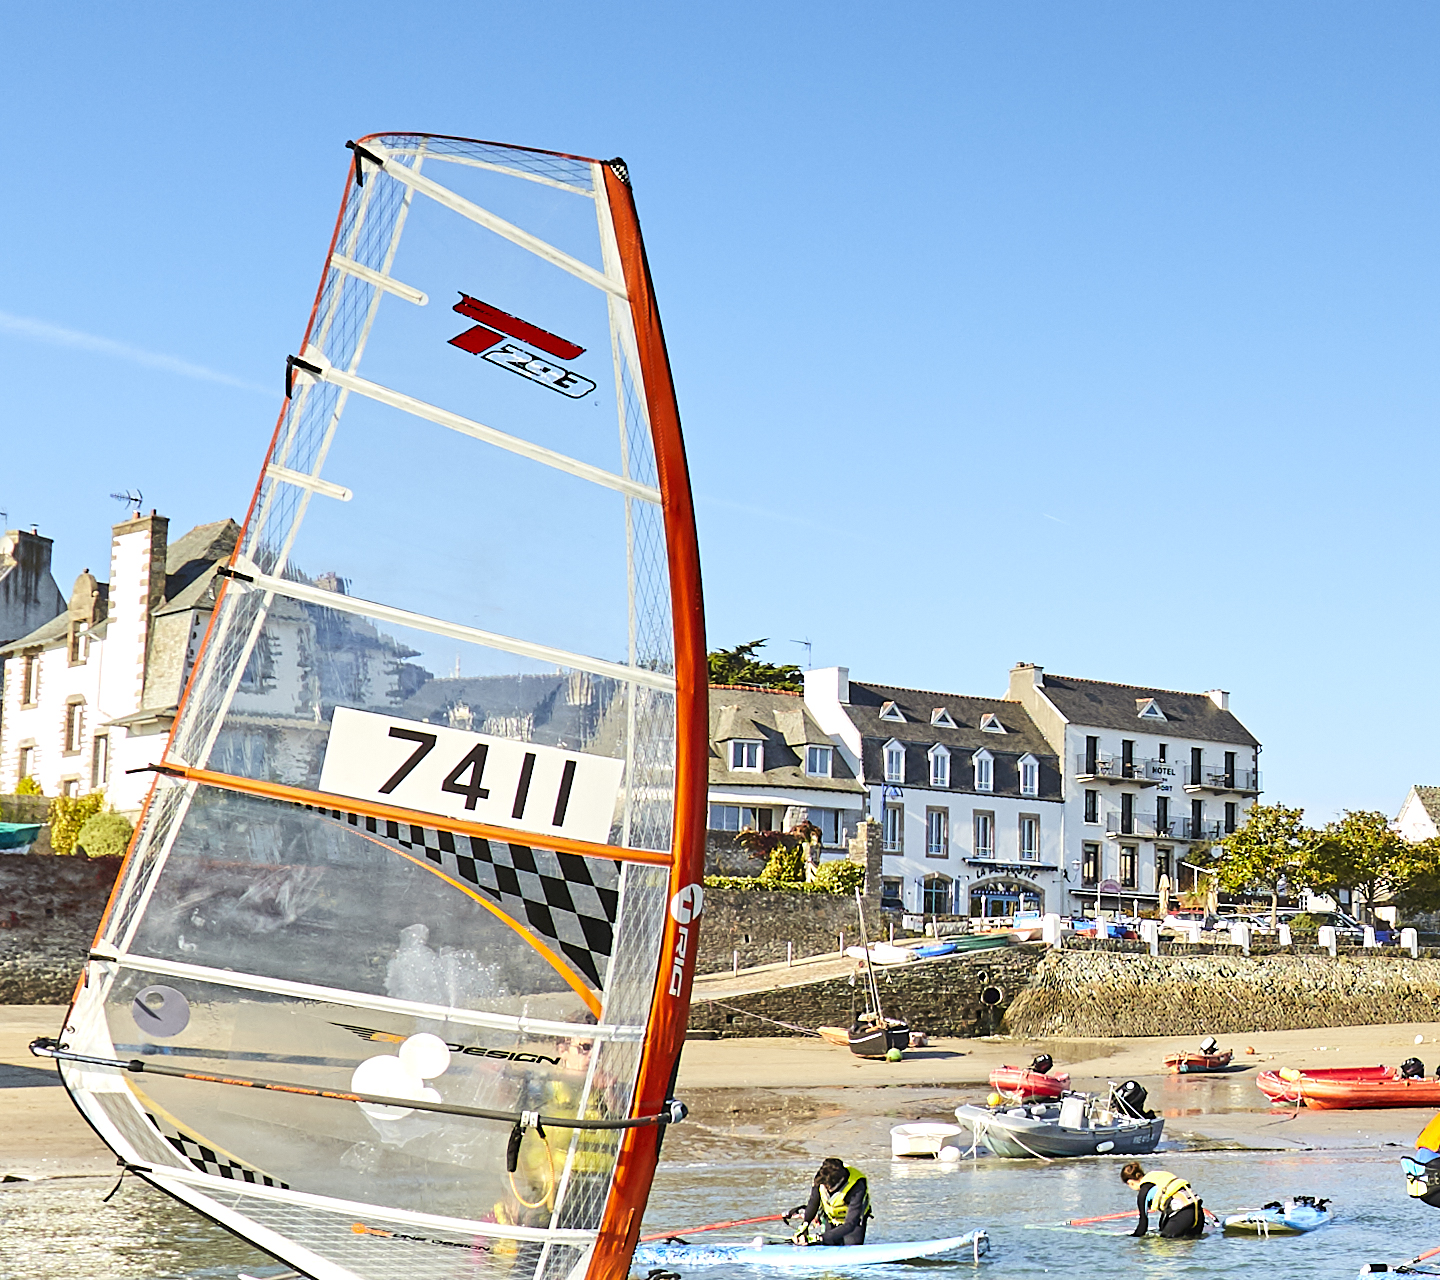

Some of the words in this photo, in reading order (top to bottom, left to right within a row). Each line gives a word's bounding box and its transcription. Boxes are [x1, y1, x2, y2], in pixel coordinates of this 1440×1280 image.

[378, 726, 577, 827] 7411
[976, 867, 986, 879] LA
[668, 926, 688, 998] RIG
[446, 1042, 561, 1065] DESIGN
